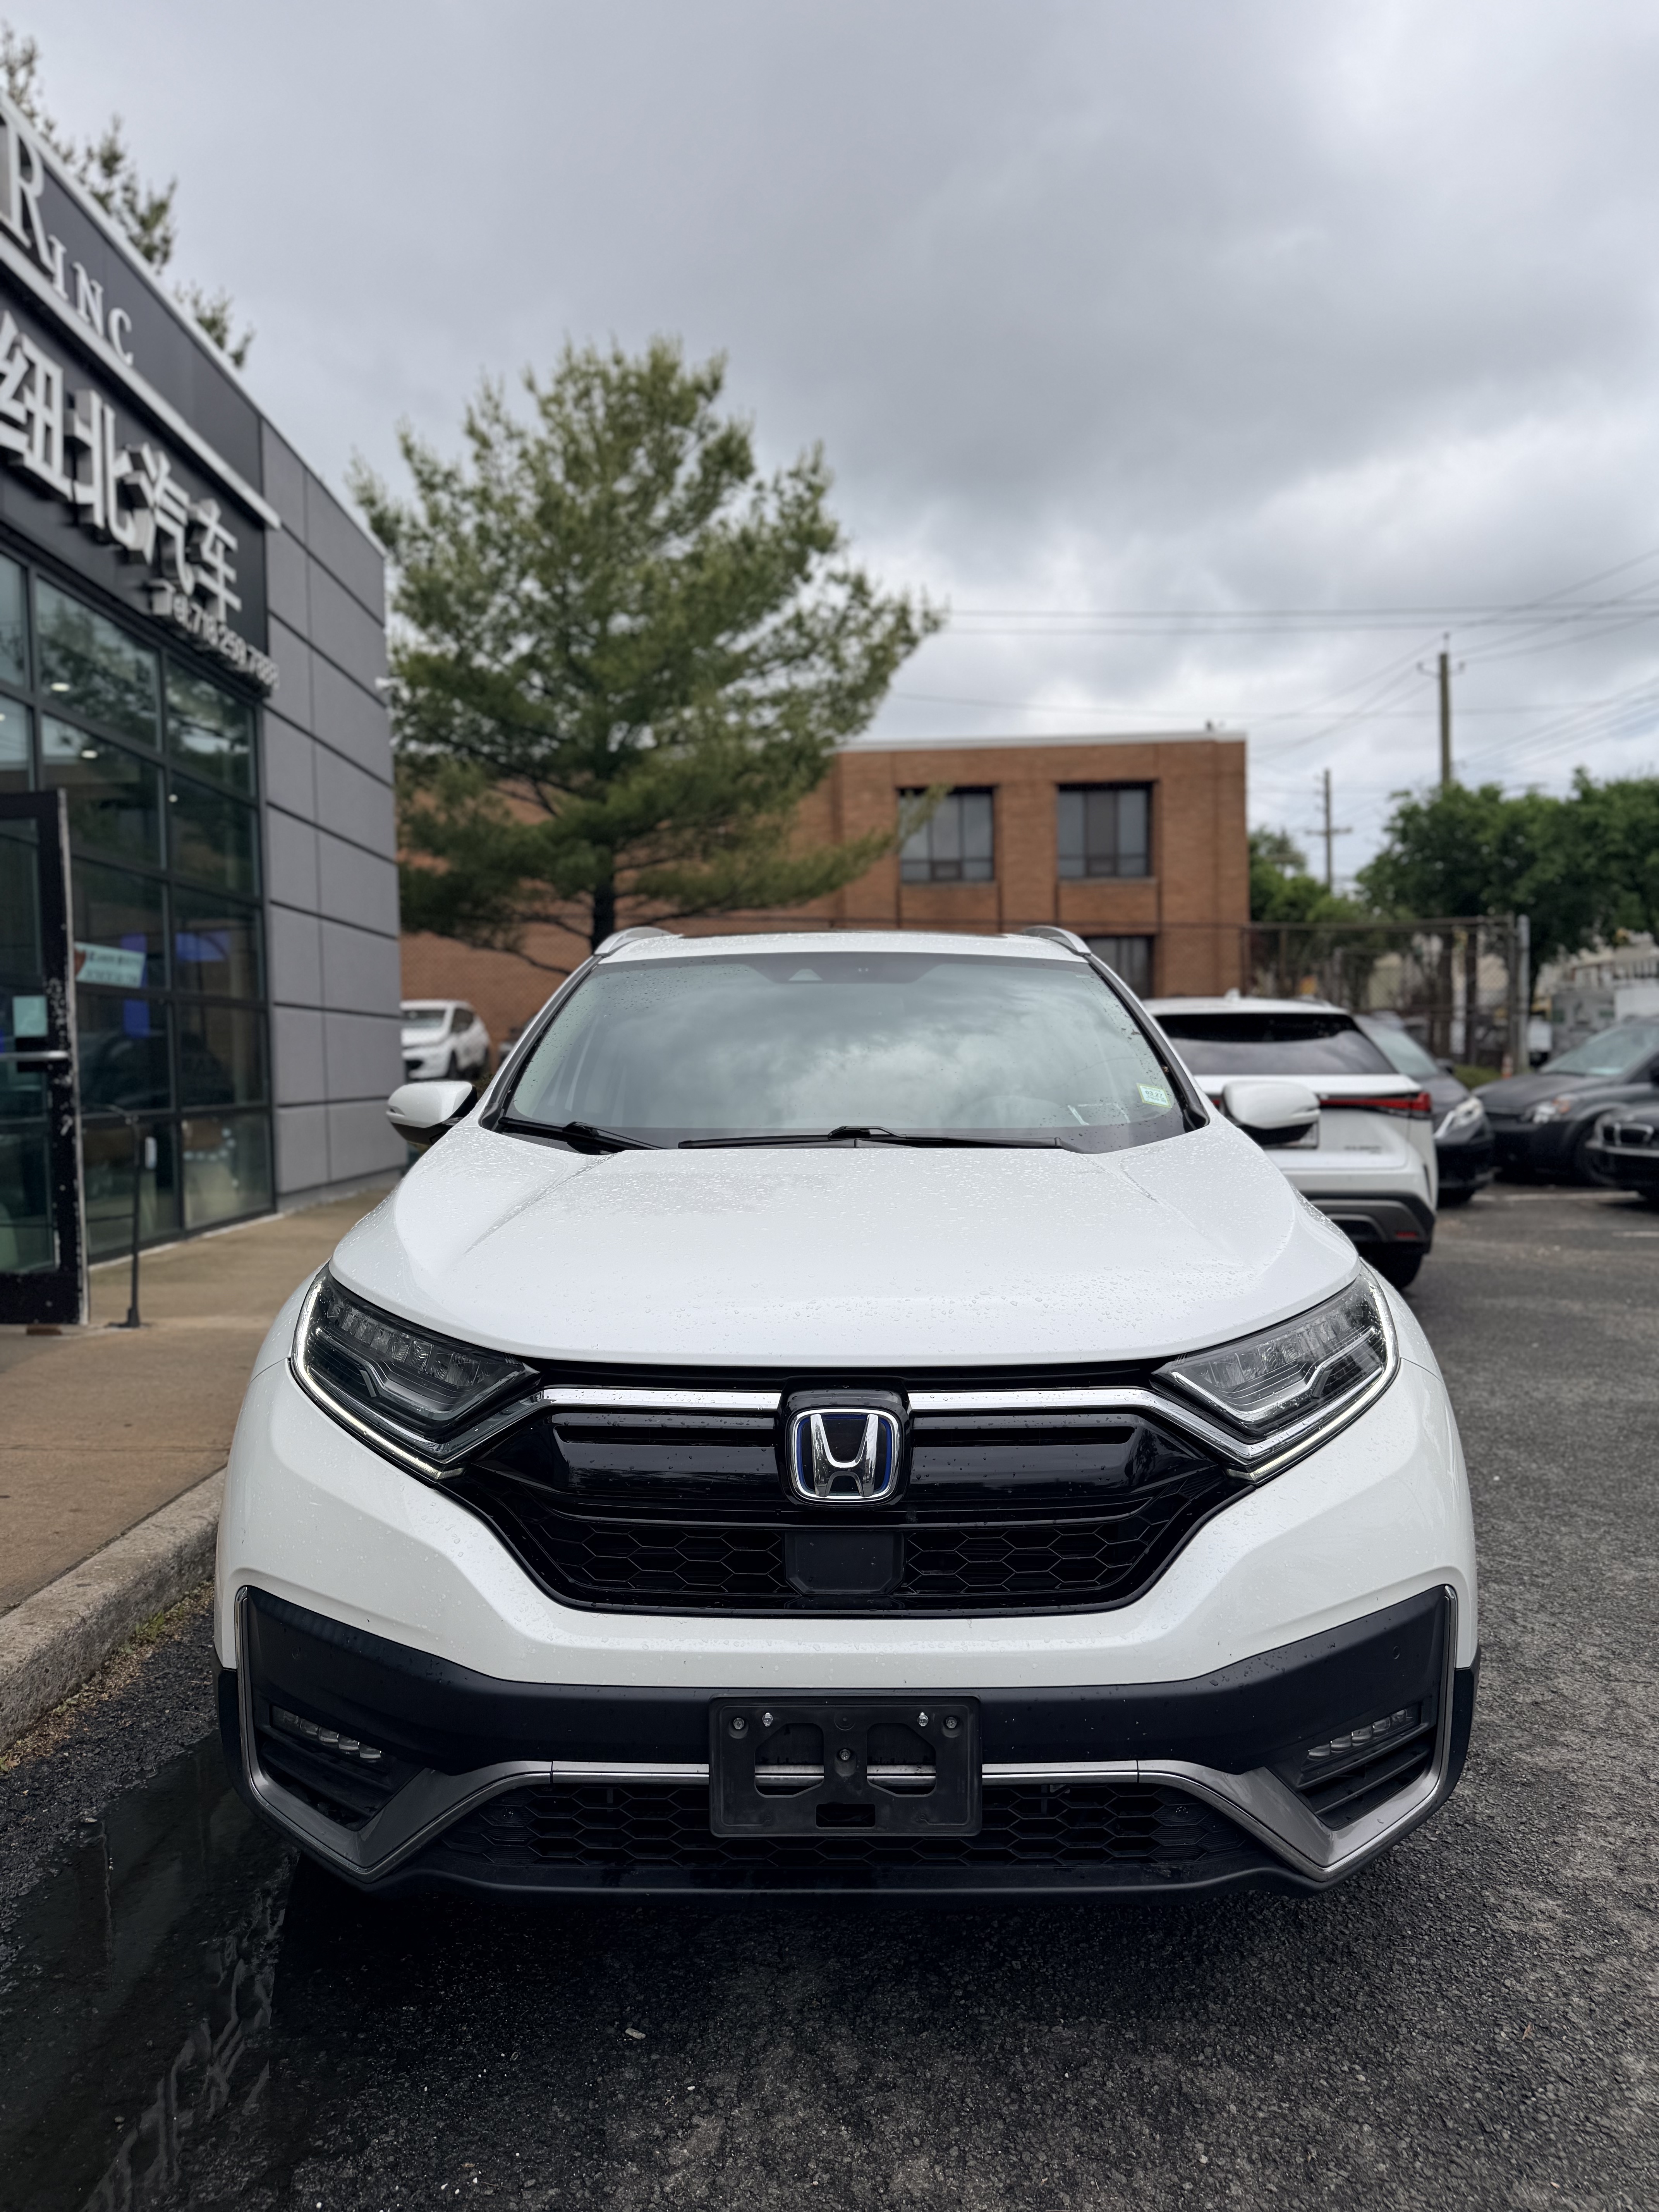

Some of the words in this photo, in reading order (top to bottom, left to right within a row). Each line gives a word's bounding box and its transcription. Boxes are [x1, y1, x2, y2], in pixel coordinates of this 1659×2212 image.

[46, 234, 134, 366] INC
[0, 308, 242, 622] 纽北汽车
